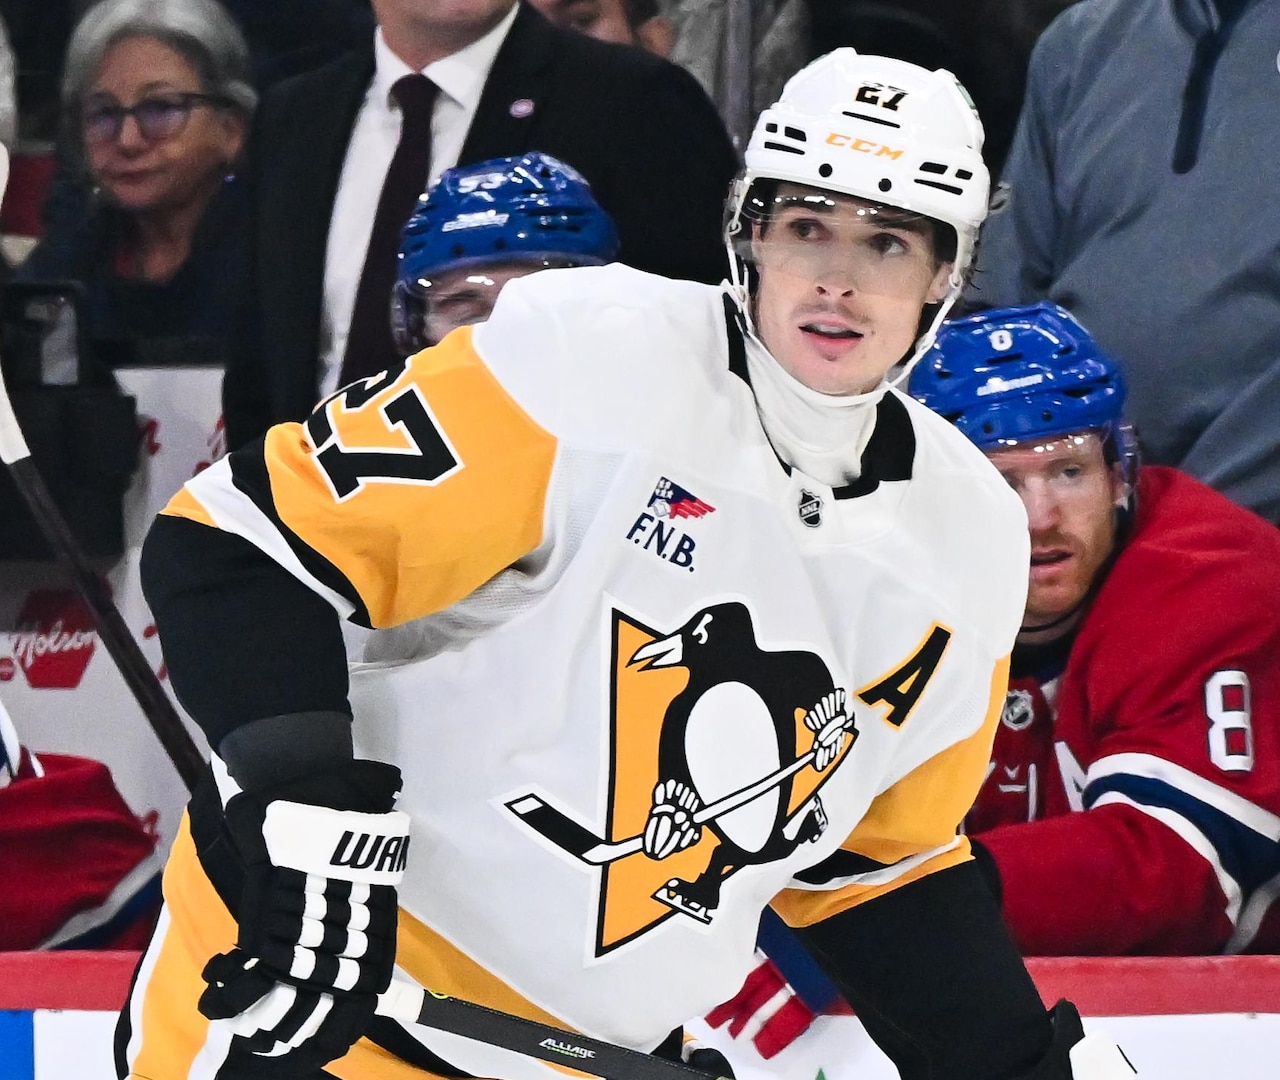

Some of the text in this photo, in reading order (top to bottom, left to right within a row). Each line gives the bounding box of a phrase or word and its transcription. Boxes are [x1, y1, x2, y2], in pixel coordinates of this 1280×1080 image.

[854, 80, 908, 112] 27
[825, 132, 904, 160] CCM
[303, 355, 466, 504] 27
[626, 512, 696, 573] F.N.B.
[854, 621, 955, 731] A
[1204, 669, 1256, 773] 8
